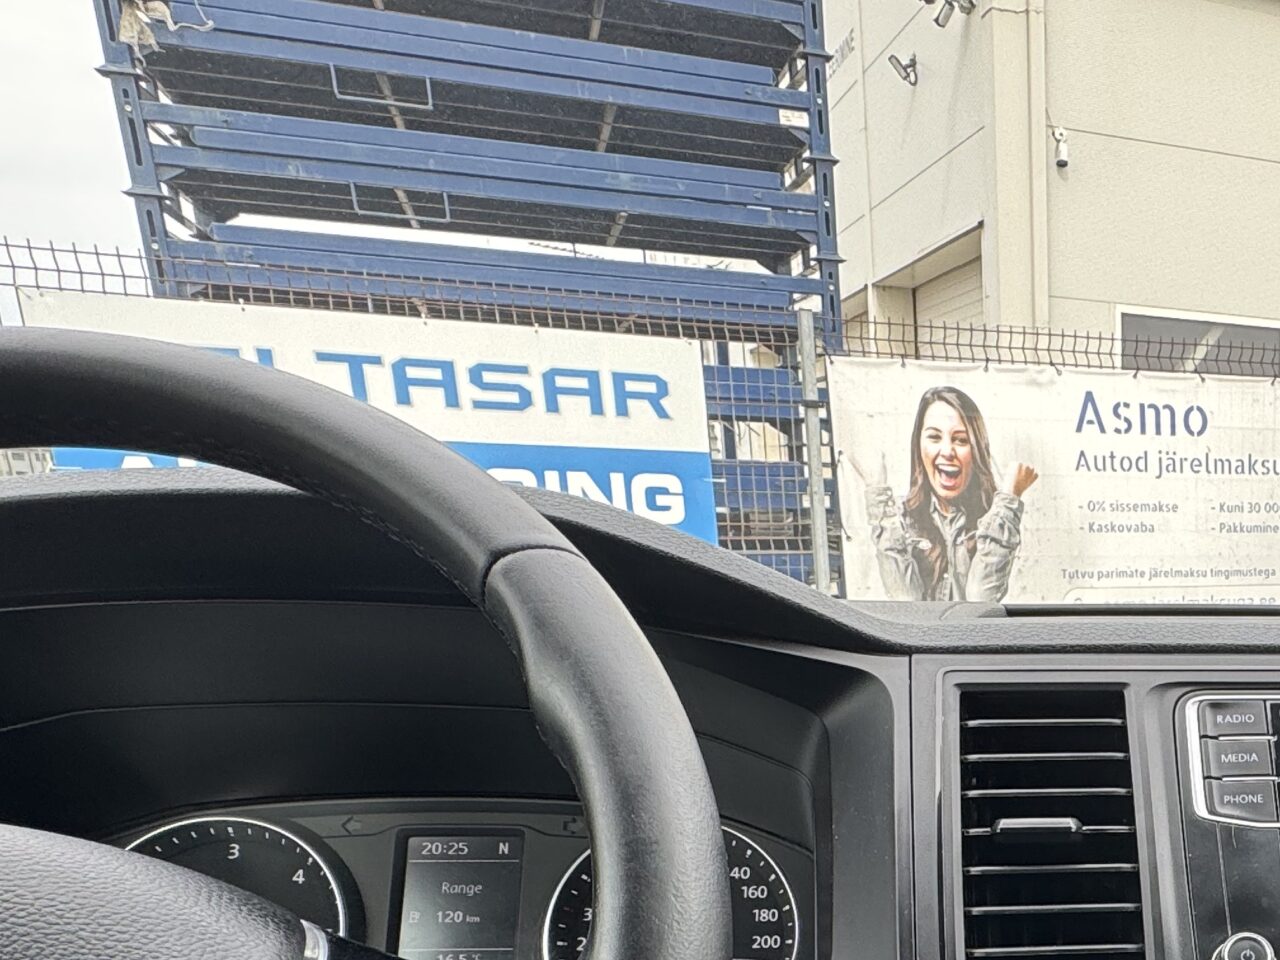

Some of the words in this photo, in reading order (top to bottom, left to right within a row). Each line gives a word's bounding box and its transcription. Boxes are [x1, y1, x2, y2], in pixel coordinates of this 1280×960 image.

[1075, 391, 1208, 437] Asmo
[1075, 450, 1148, 472] Autod
[1087, 500, 1106, 512] 0%
[1109, 500, 1179, 513] sissemakse
[1219, 502, 1244, 513] Kuni
[1248, 502, 1261, 513] 30
[1088, 521, 1155, 533] Kaskovaba
[1219, 522, 1280, 534] Pakkumine
[1061, 569, 1094, 579] Tutvu
[1097, 568, 1146, 581] parimate
[1148, 568, 1207, 581] järelmaksu
[1210, 567, 1276, 580] tingimustega
[1216, 714, 1255, 724] RADIO
[1221, 753, 1259, 763] MEDIA
[1223, 794, 1264, 804] PHONE
[421, 842, 469, 855] 20:25
[498, 842, 509, 854] N
[227, 844, 240, 859] 3
[292, 869, 305, 884] 4
[729, 866, 751, 879] 40
[441, 881, 483, 896] Range
[741, 885, 768, 899] 160
[436, 911, 463, 923] 120
[466, 915, 480, 923] km
[752, 908, 779, 922] 180
[751, 935, 781, 949] 200
